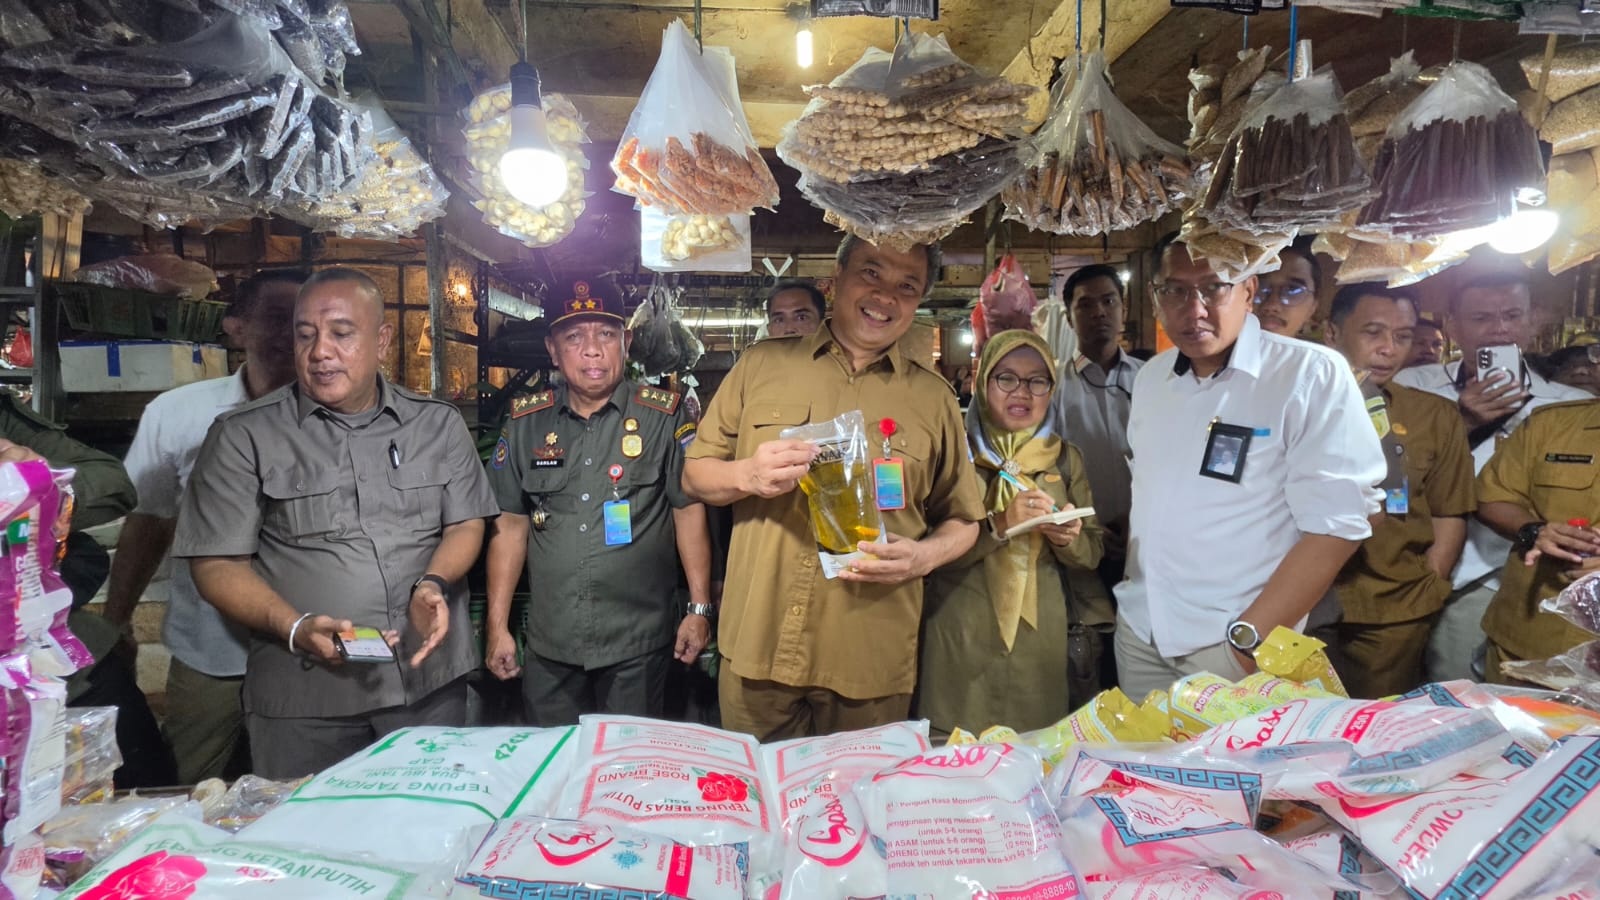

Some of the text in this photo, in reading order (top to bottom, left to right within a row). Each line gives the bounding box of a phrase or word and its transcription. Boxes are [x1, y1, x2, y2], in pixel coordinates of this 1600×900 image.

[408, 757, 445, 765] CAP
[597, 768, 690, 783] ROSE BRAND
[325, 775, 493, 795] TEPUNG TAPIOKA
[789, 783, 833, 809] BRND
[645, 804, 692, 813] BERAS
[695, 803, 753, 813] TEPUNG
[895, 839, 918, 848] ASAM
[1396, 807, 1465, 871] OWDER
[921, 848, 946, 857] (untuk
[961, 846, 987, 856] orang)
[144, 838, 378, 895] TEPNG KETAN PUTIH
[931, 859, 954, 867] untuk
